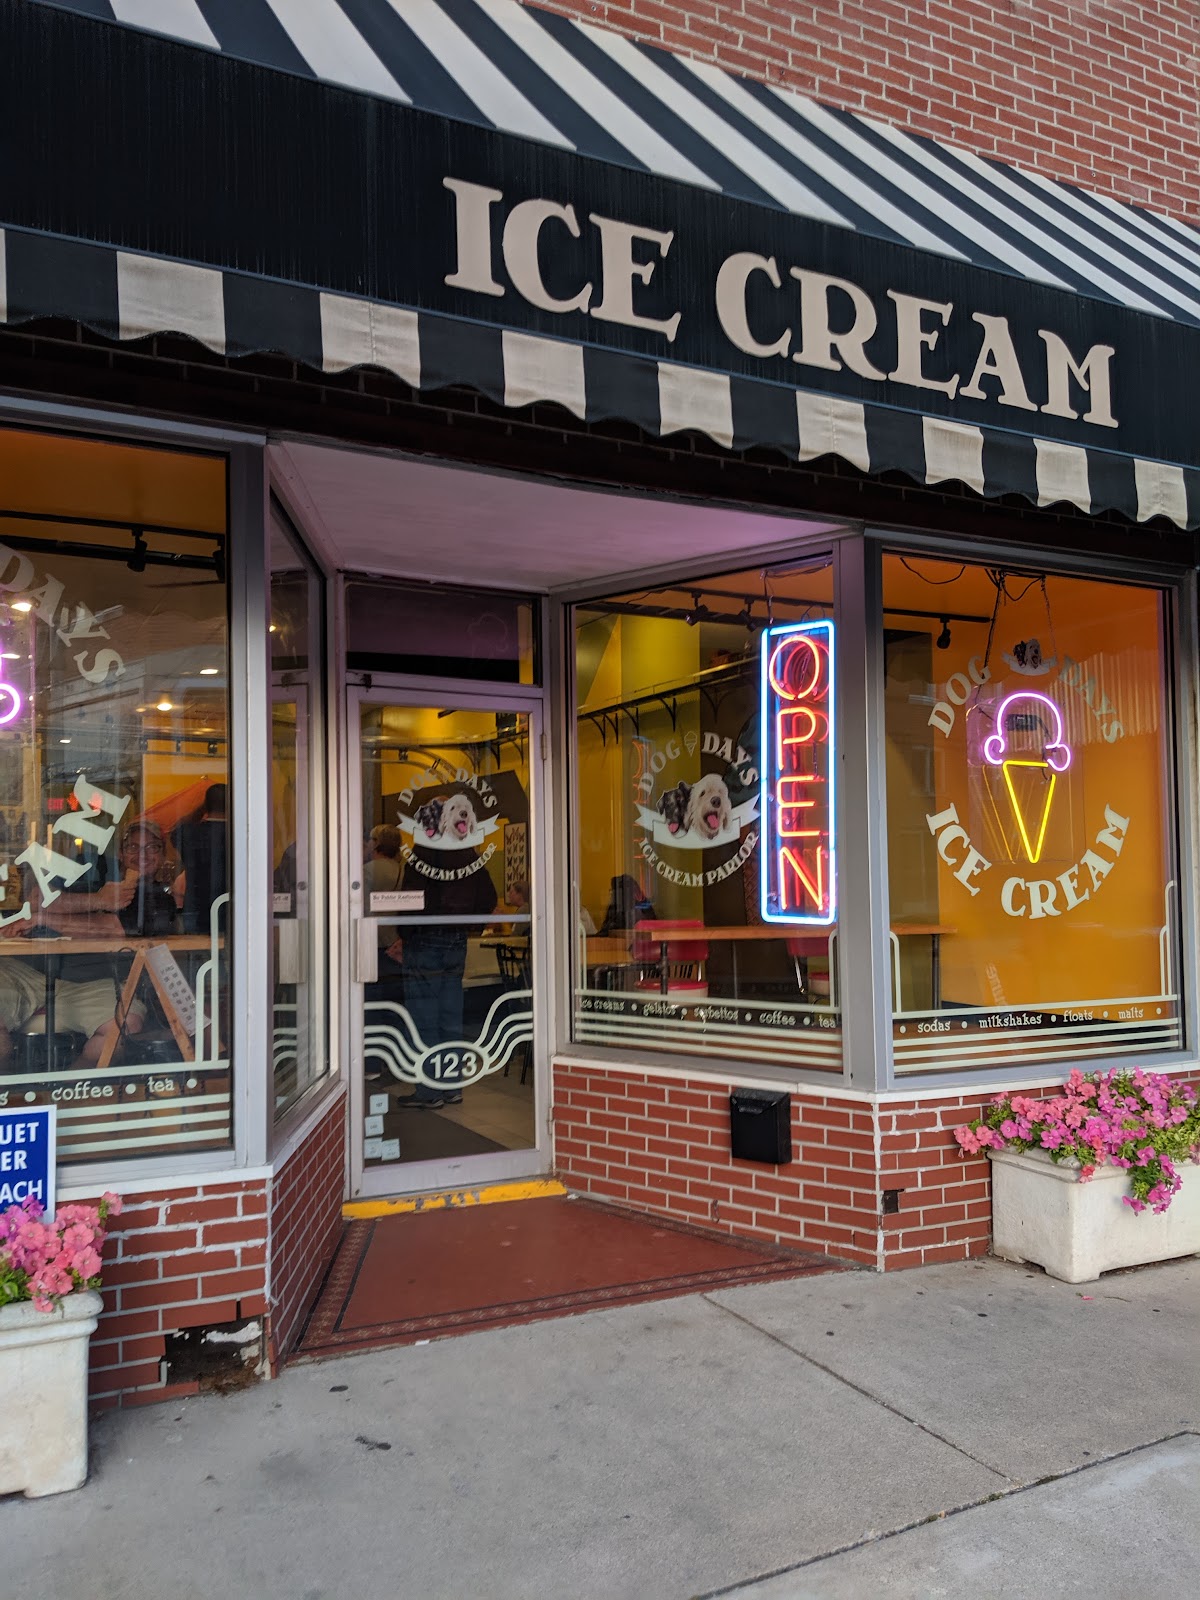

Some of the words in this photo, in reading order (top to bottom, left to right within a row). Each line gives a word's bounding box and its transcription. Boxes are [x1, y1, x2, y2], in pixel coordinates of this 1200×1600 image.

[443, 177, 682, 342] ICE
[715, 251, 1120, 429] CREAM
[928, 655, 991, 738] DOG
[1058, 655, 1124, 744] DAYS
[638, 739, 681, 795] DOG
[701, 731, 759, 786] DAYS
[768, 634, 825, 910] OPEN
[455, 767, 498, 808] DAYS
[399, 843, 418, 866] ICE
[415, 860, 456, 881] CREAM
[456, 842, 497, 880] PARLOR
[638, 837, 655, 867] ICE
[655, 860, 704, 888] CREAM
[706, 831, 760, 886] PARLOR
[926, 802, 992, 896] ICE
[1001, 803, 1130, 919] CREAM
[594, 999, 625, 1012] creams
[643, 1001, 676, 1016] gelatos
[759, 1010, 796, 1026] coffee
[818, 1014, 836, 1029] tea
[917, 1020, 951, 1033] sodas
[978, 1013, 1043, 1029] milkshakes
[1063, 1009, 1093, 1023] floats
[1118, 1007, 1144, 1020] malts
[430, 1051, 478, 1079] 123
[51, 1080, 114, 1102] coffee
[148, 1076, 175, 1093] tea
[0, 1121, 40, 1145] UET
[0, 1149, 28, 1172] ER
